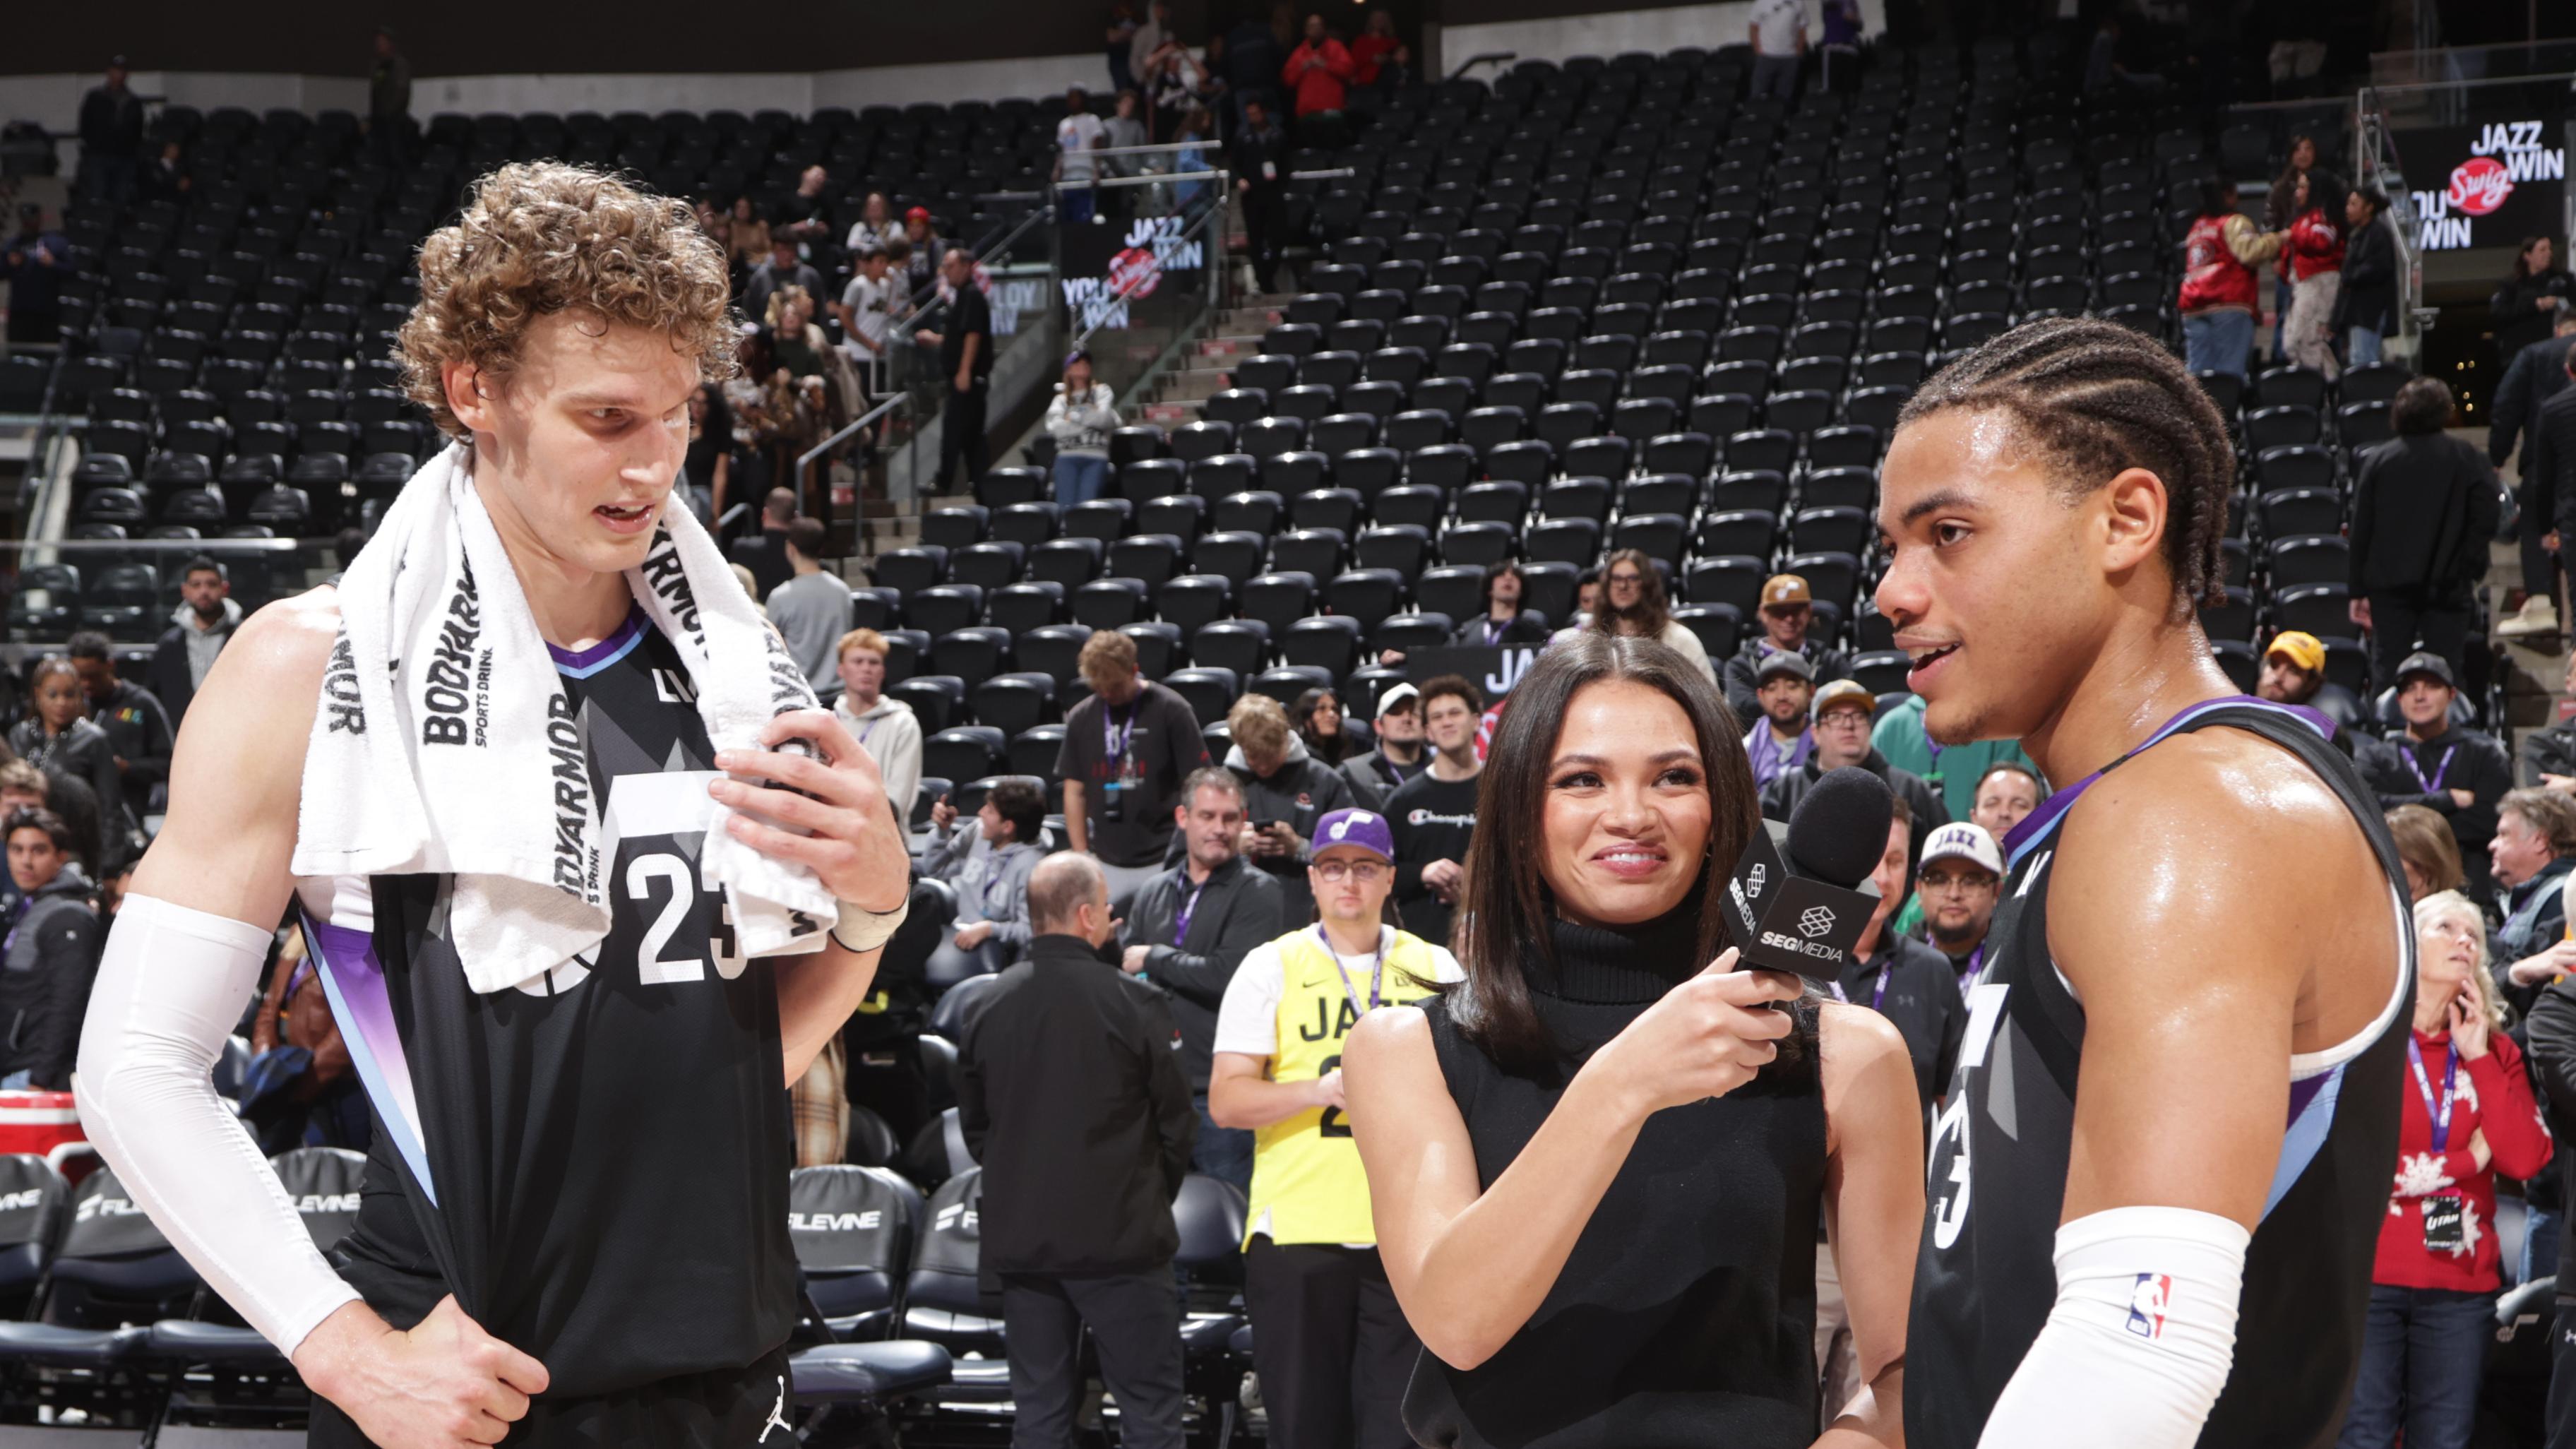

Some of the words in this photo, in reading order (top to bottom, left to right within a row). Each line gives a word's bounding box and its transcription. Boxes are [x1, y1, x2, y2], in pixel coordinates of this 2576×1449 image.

[2471, 120, 2543, 156] JAZZ
[2506, 148, 2565, 182] WIN
[2447, 163, 2514, 208] Swig
[2411, 189, 2447, 220] OU
[1125, 216, 1184, 247] JAZZ
[477, 646, 493, 691] DRINK
[1485, 648, 1534, 693] JA
[475, 693, 489, 748] SPORTS
[1407, 809, 1477, 829] Champi
[1936, 829, 1976, 849] JAZZ
[1729, 877, 1756, 936] SEGMEDIA
[1760, 931, 1844, 962] SEGMEDIA
[1299, 997, 1417, 1042] JA
[2426, 1214, 2459, 1231] UTAH
